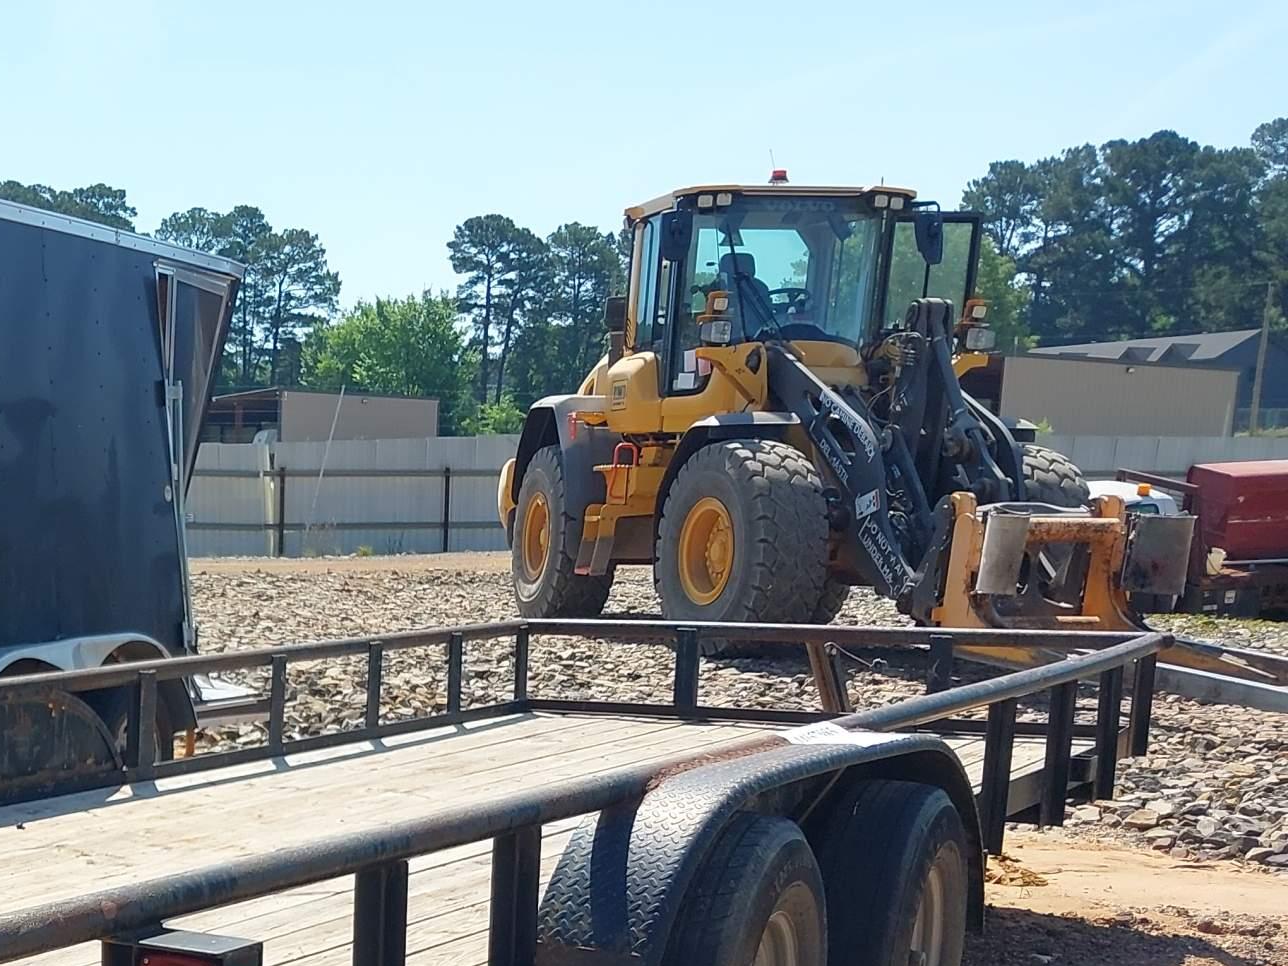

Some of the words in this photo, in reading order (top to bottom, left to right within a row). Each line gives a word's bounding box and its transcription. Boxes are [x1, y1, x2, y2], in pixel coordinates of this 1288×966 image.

[819, 390, 832, 408] NO
[819, 439, 832, 457] DEL
[876, 530, 892, 554] NOT
